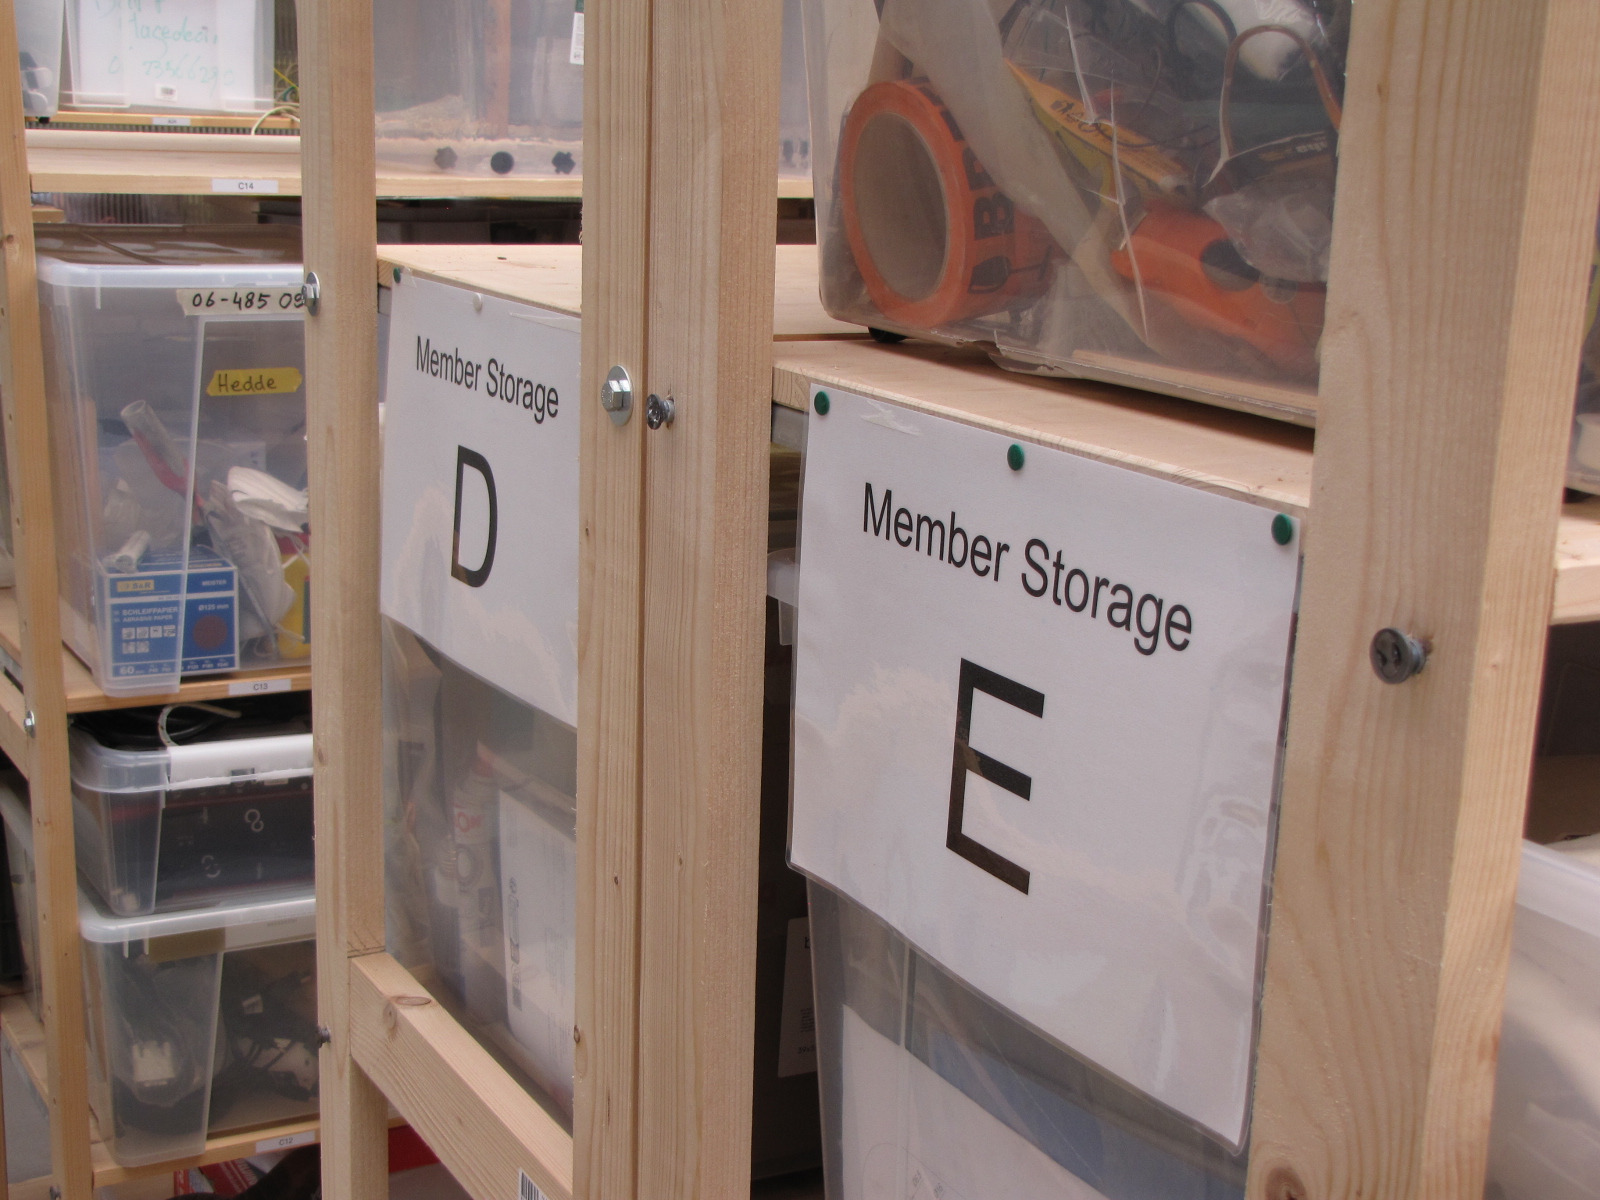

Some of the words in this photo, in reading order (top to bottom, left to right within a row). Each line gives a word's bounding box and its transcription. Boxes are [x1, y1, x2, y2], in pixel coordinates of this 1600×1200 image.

[238, 182, 254, 190] C14
[192, 291, 271, 311] 06-485
[218, 373, 277, 393] Hedde
[416, 335, 482, 391] Member
[486, 358, 559, 424] Storage
[451, 444, 498, 588] D
[862, 482, 1010, 582] Member
[1021, 538, 1193, 656] Storage
[201, 579, 227, 587] MEISTER
[122, 606, 179, 616] SCHLEIFPAPIER
[120, 666, 135, 675] 60
[253, 682, 269, 691] C13
[945, 657, 1045, 896] E
[279, 1137, 294, 1146] C12
